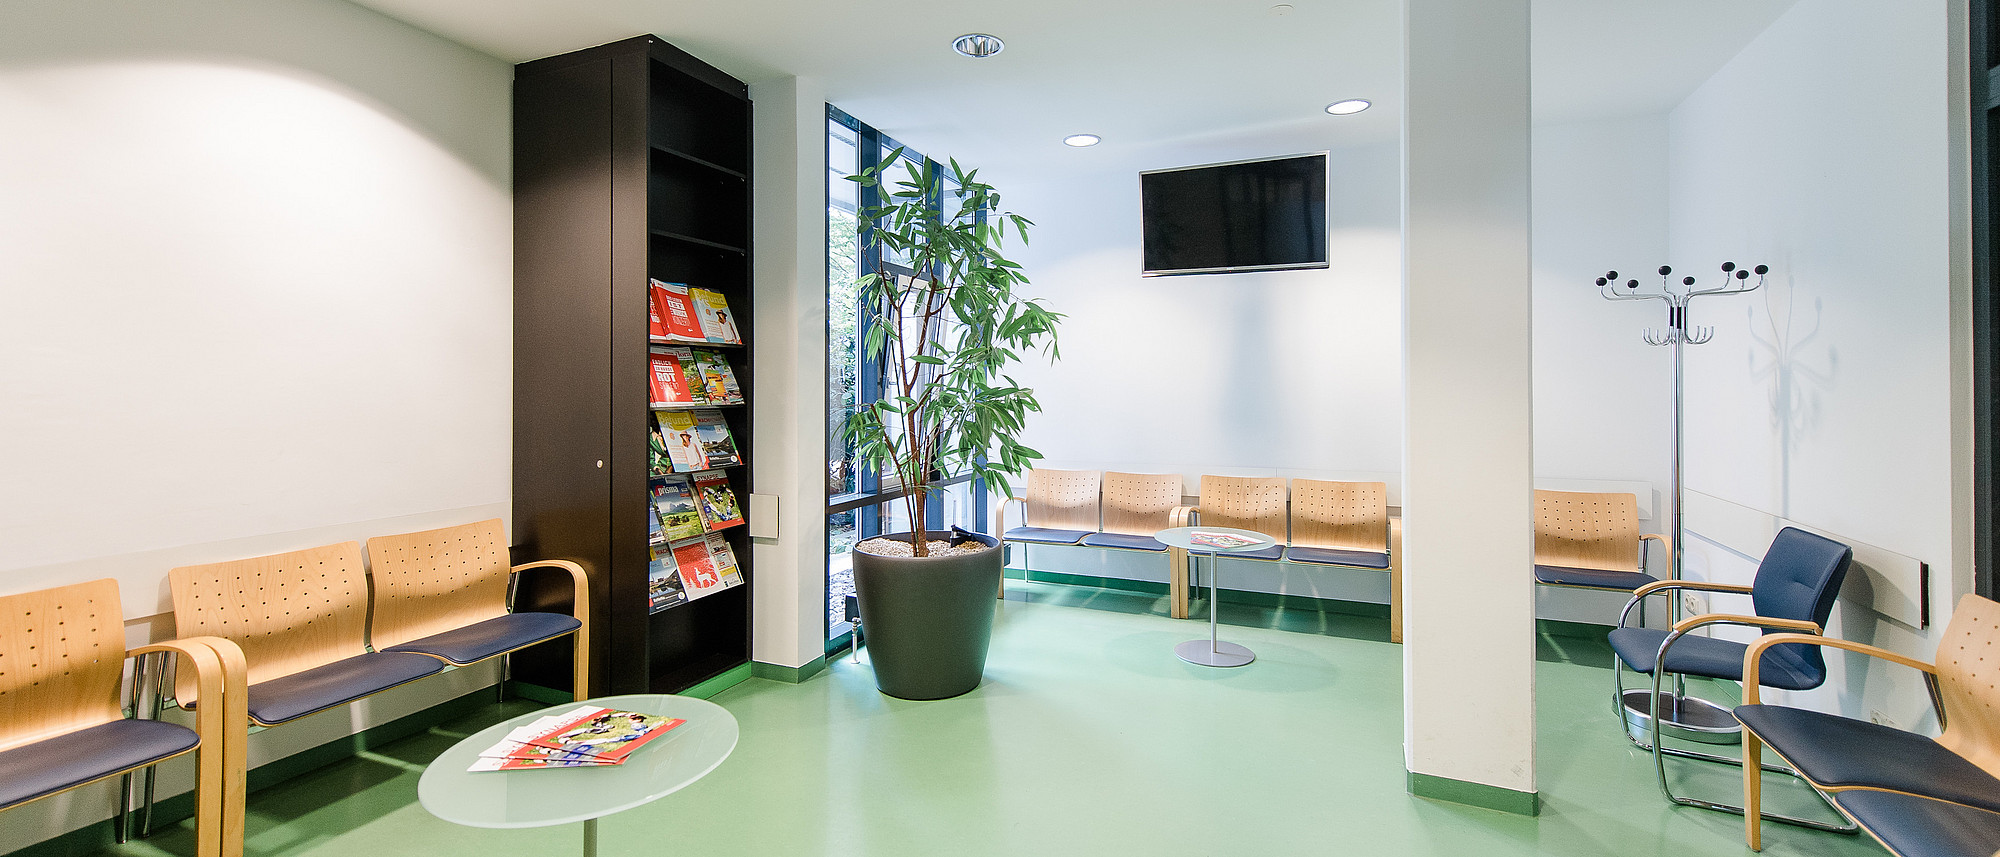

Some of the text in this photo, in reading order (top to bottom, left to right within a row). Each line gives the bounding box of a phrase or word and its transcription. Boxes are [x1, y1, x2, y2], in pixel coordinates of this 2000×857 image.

[693, 290, 726, 305] Befund
[656, 372, 676, 382] ROT
[657, 413, 691, 425] Befund
[696, 473, 720, 481] SYNAPSE
[658, 485, 679, 496] prisma
